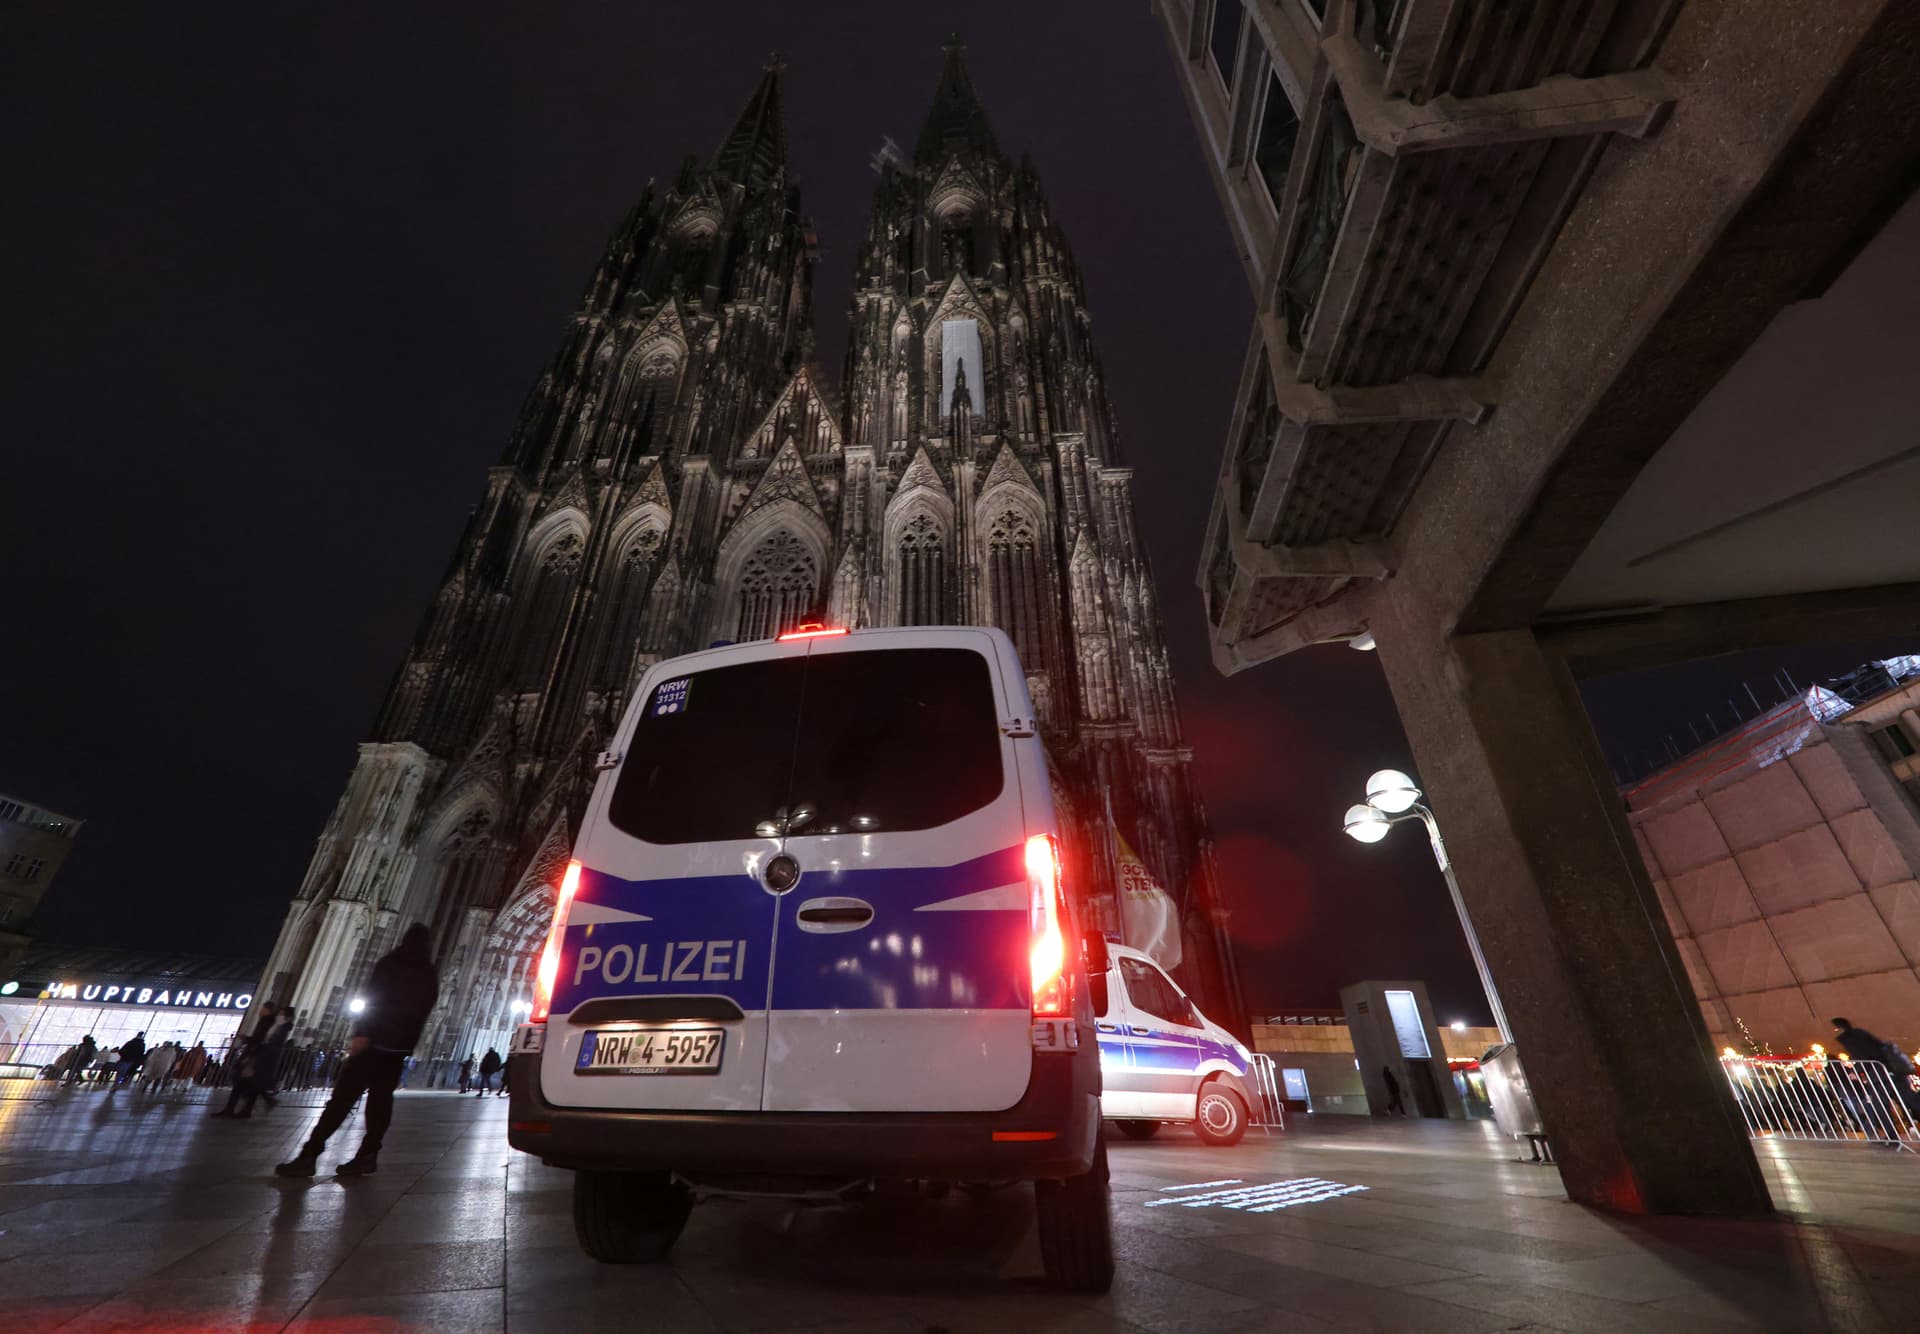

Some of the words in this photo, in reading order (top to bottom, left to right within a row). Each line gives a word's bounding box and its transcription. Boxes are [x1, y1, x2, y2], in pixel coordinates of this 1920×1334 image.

[658, 679, 689, 694] NRW
[656, 691, 686, 704] 31312
[573, 940, 747, 986] POLIZEI
[591, 1036, 633, 1064] NRW
